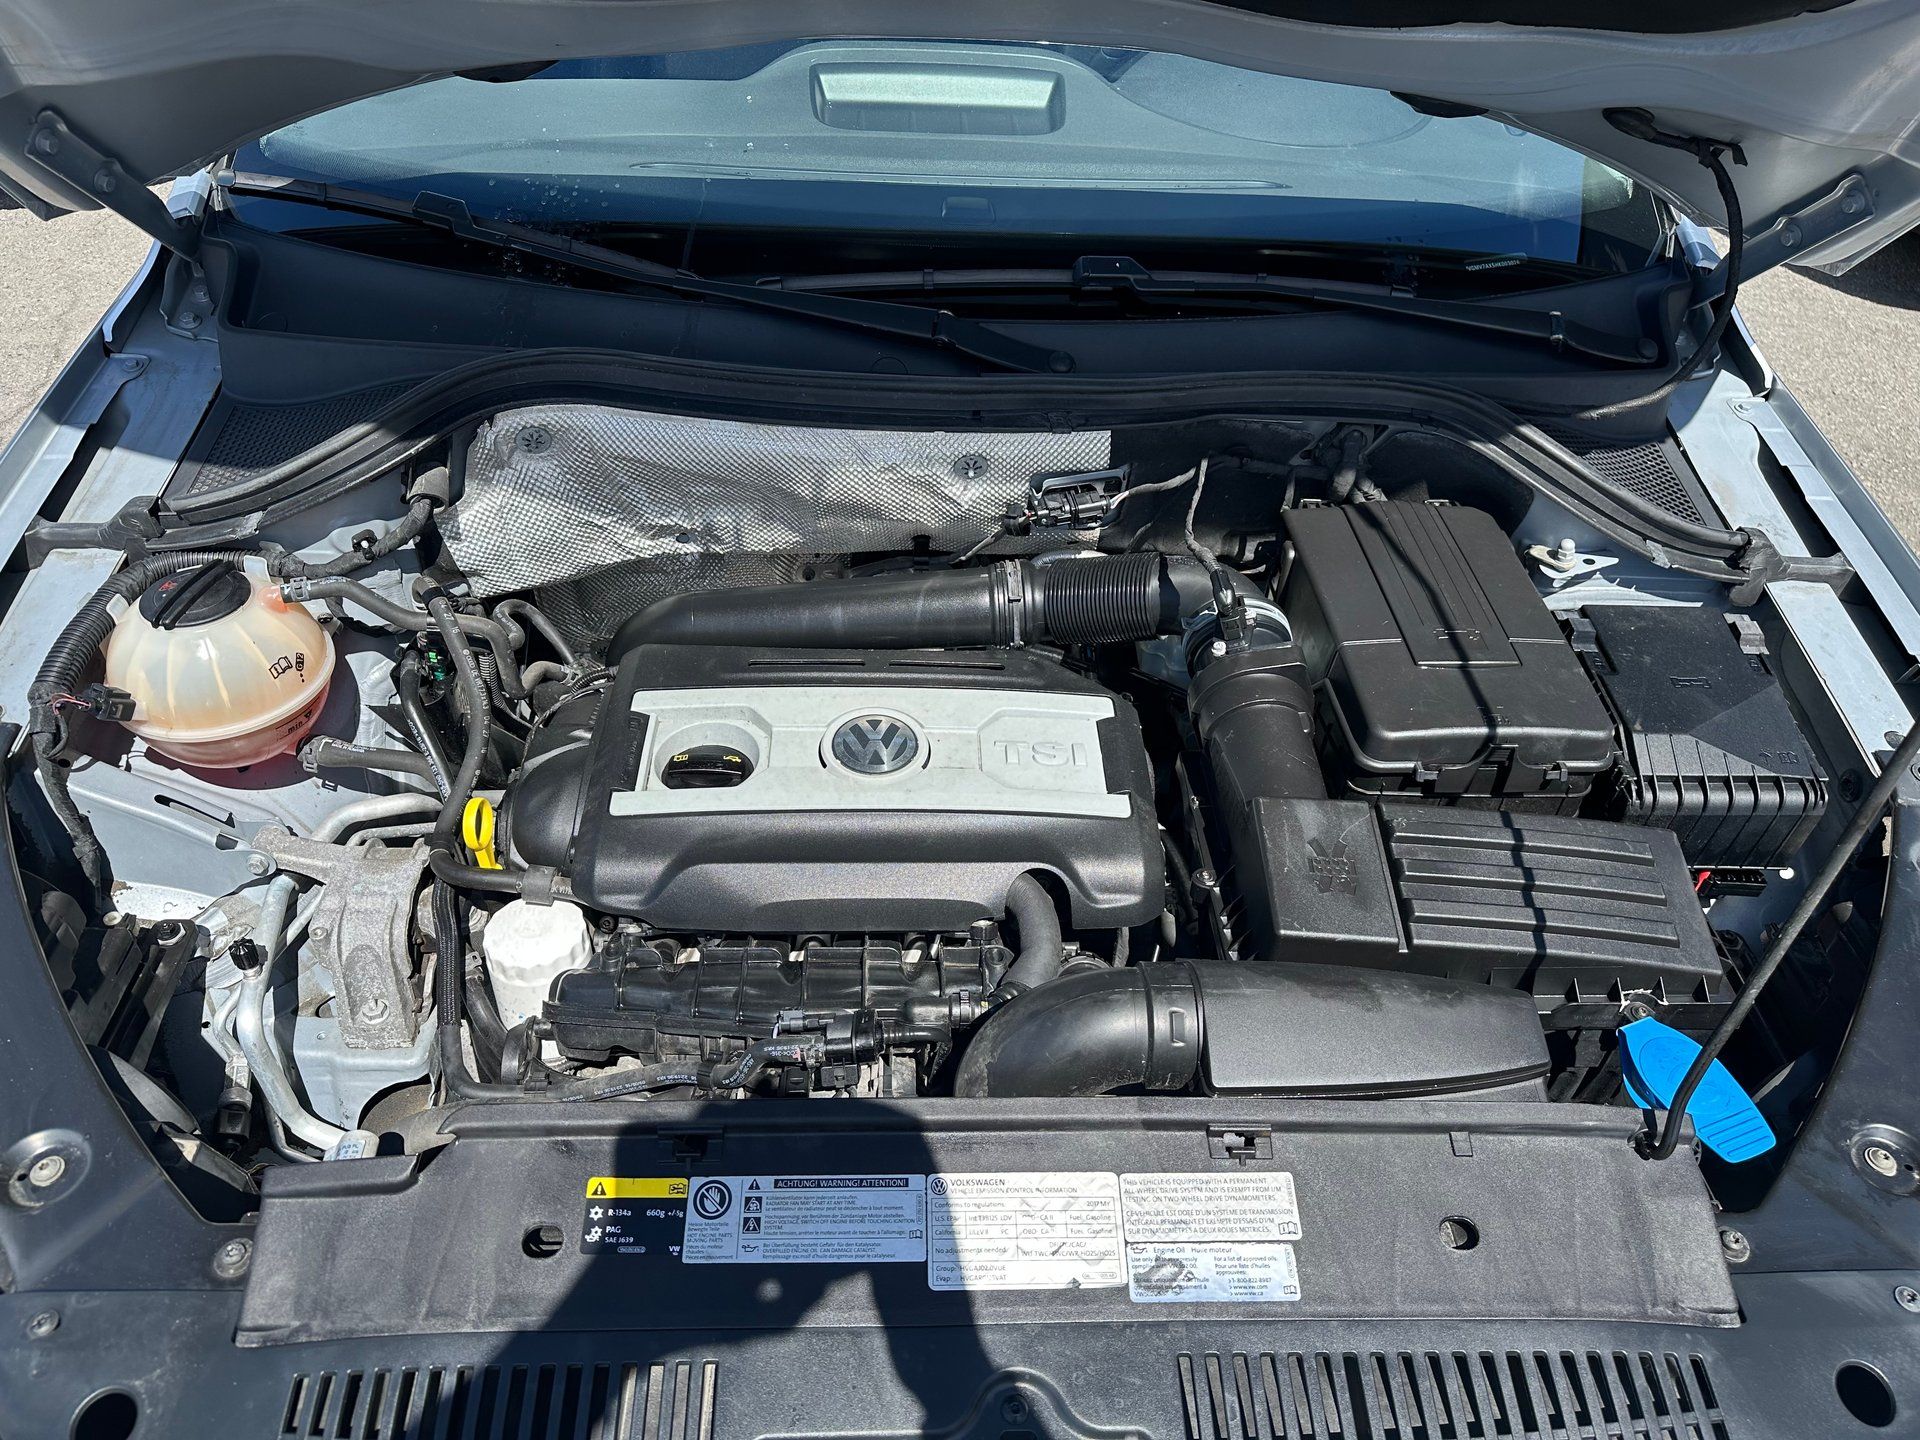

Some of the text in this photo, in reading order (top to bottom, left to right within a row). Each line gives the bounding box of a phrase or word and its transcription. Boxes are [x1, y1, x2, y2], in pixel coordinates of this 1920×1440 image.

[295, 653, 304, 671] G12
[288, 721, 303, 734] min
[994, 740, 1088, 767] TSI
[776, 1179, 906, 1188] ACHTUNG! WARNING! ATTENTION!
[1173, 1178, 1203, 1186] EQUIPPED
[608, 1208, 632, 1216] R-134a
[646, 1210, 665, 1218] 660g
[945, 1247, 982, 1255] adjustments
